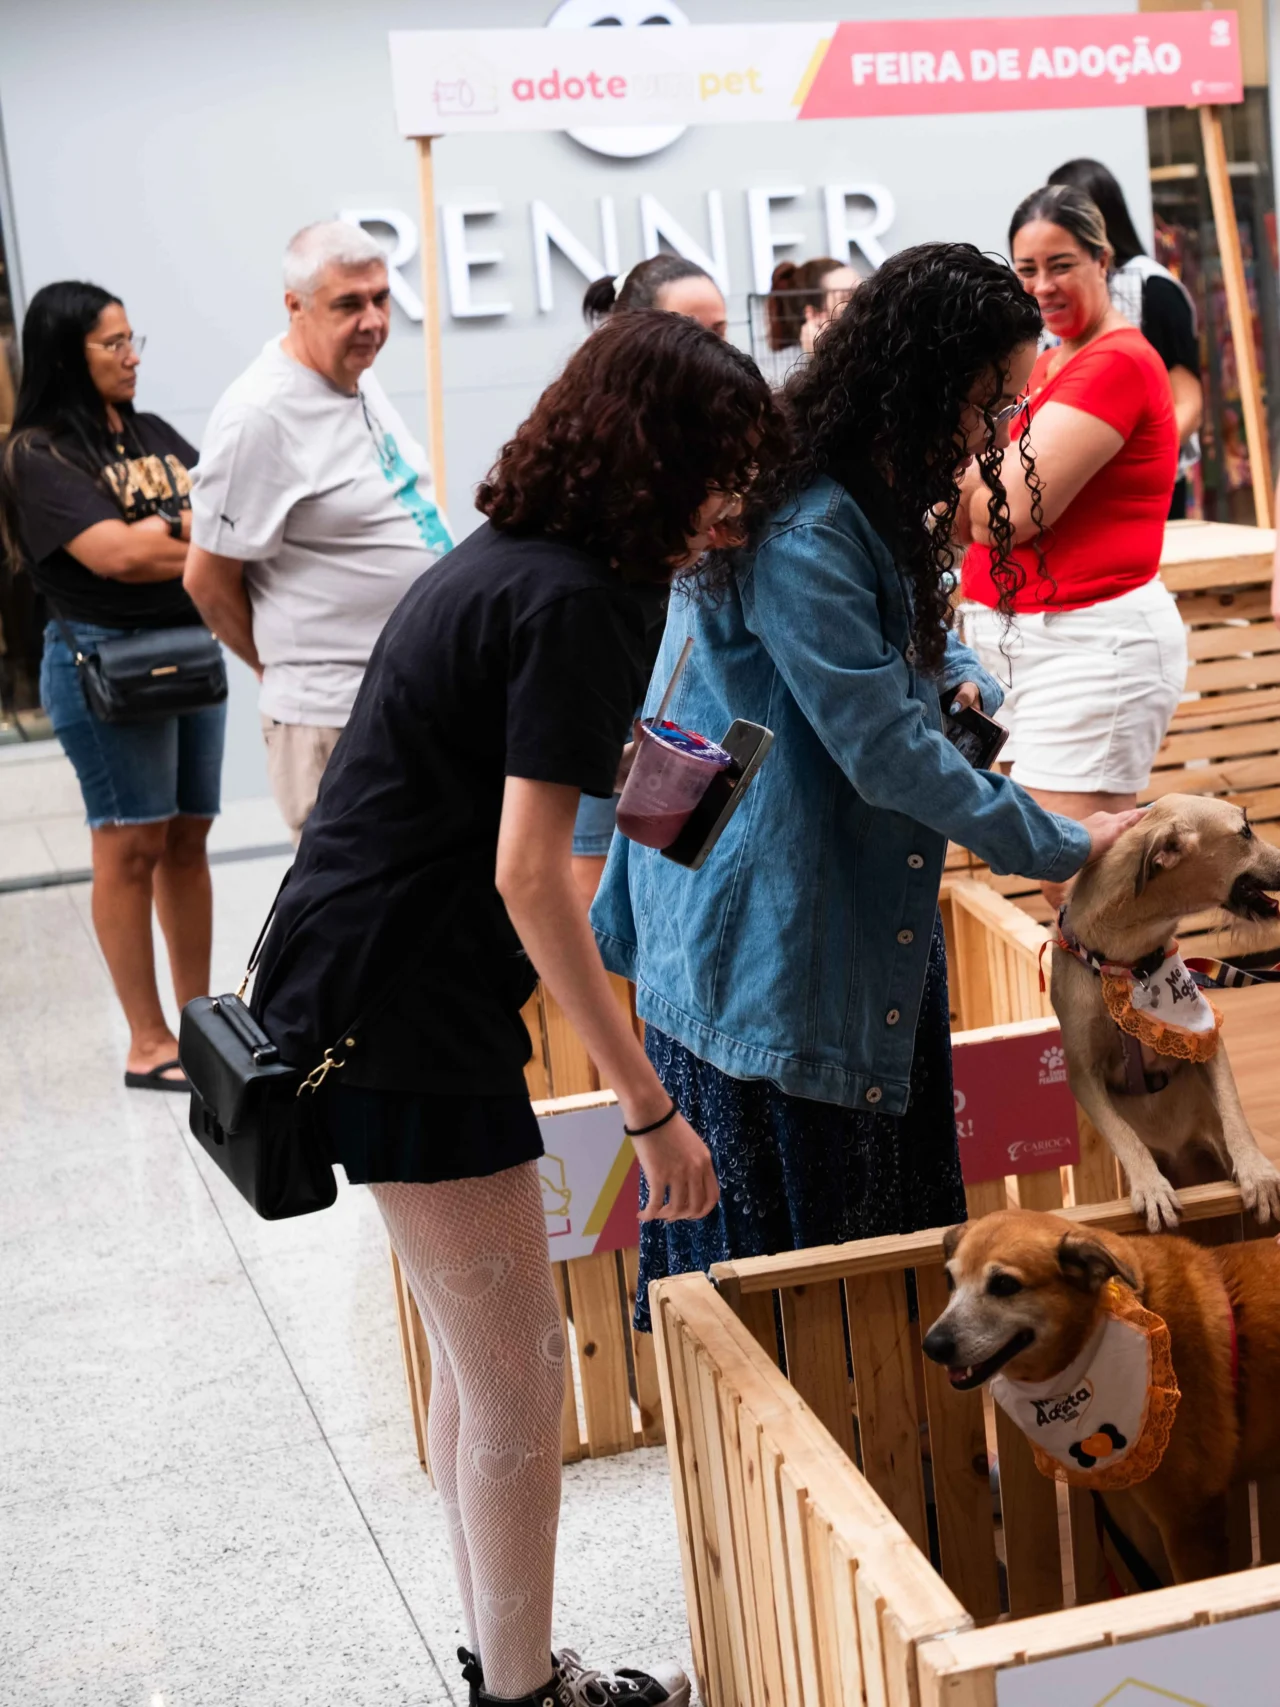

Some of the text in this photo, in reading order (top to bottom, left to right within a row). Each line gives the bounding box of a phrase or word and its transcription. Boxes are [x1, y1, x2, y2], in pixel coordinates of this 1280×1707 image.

[851, 36, 1181, 85] FEIRA DE ADOÇÃO
[511, 68, 628, 101] adote
[699, 66, 764, 101] pet
[335, 183, 897, 322] RENNER
[1023, 1137, 1071, 1153] CARIOCA
